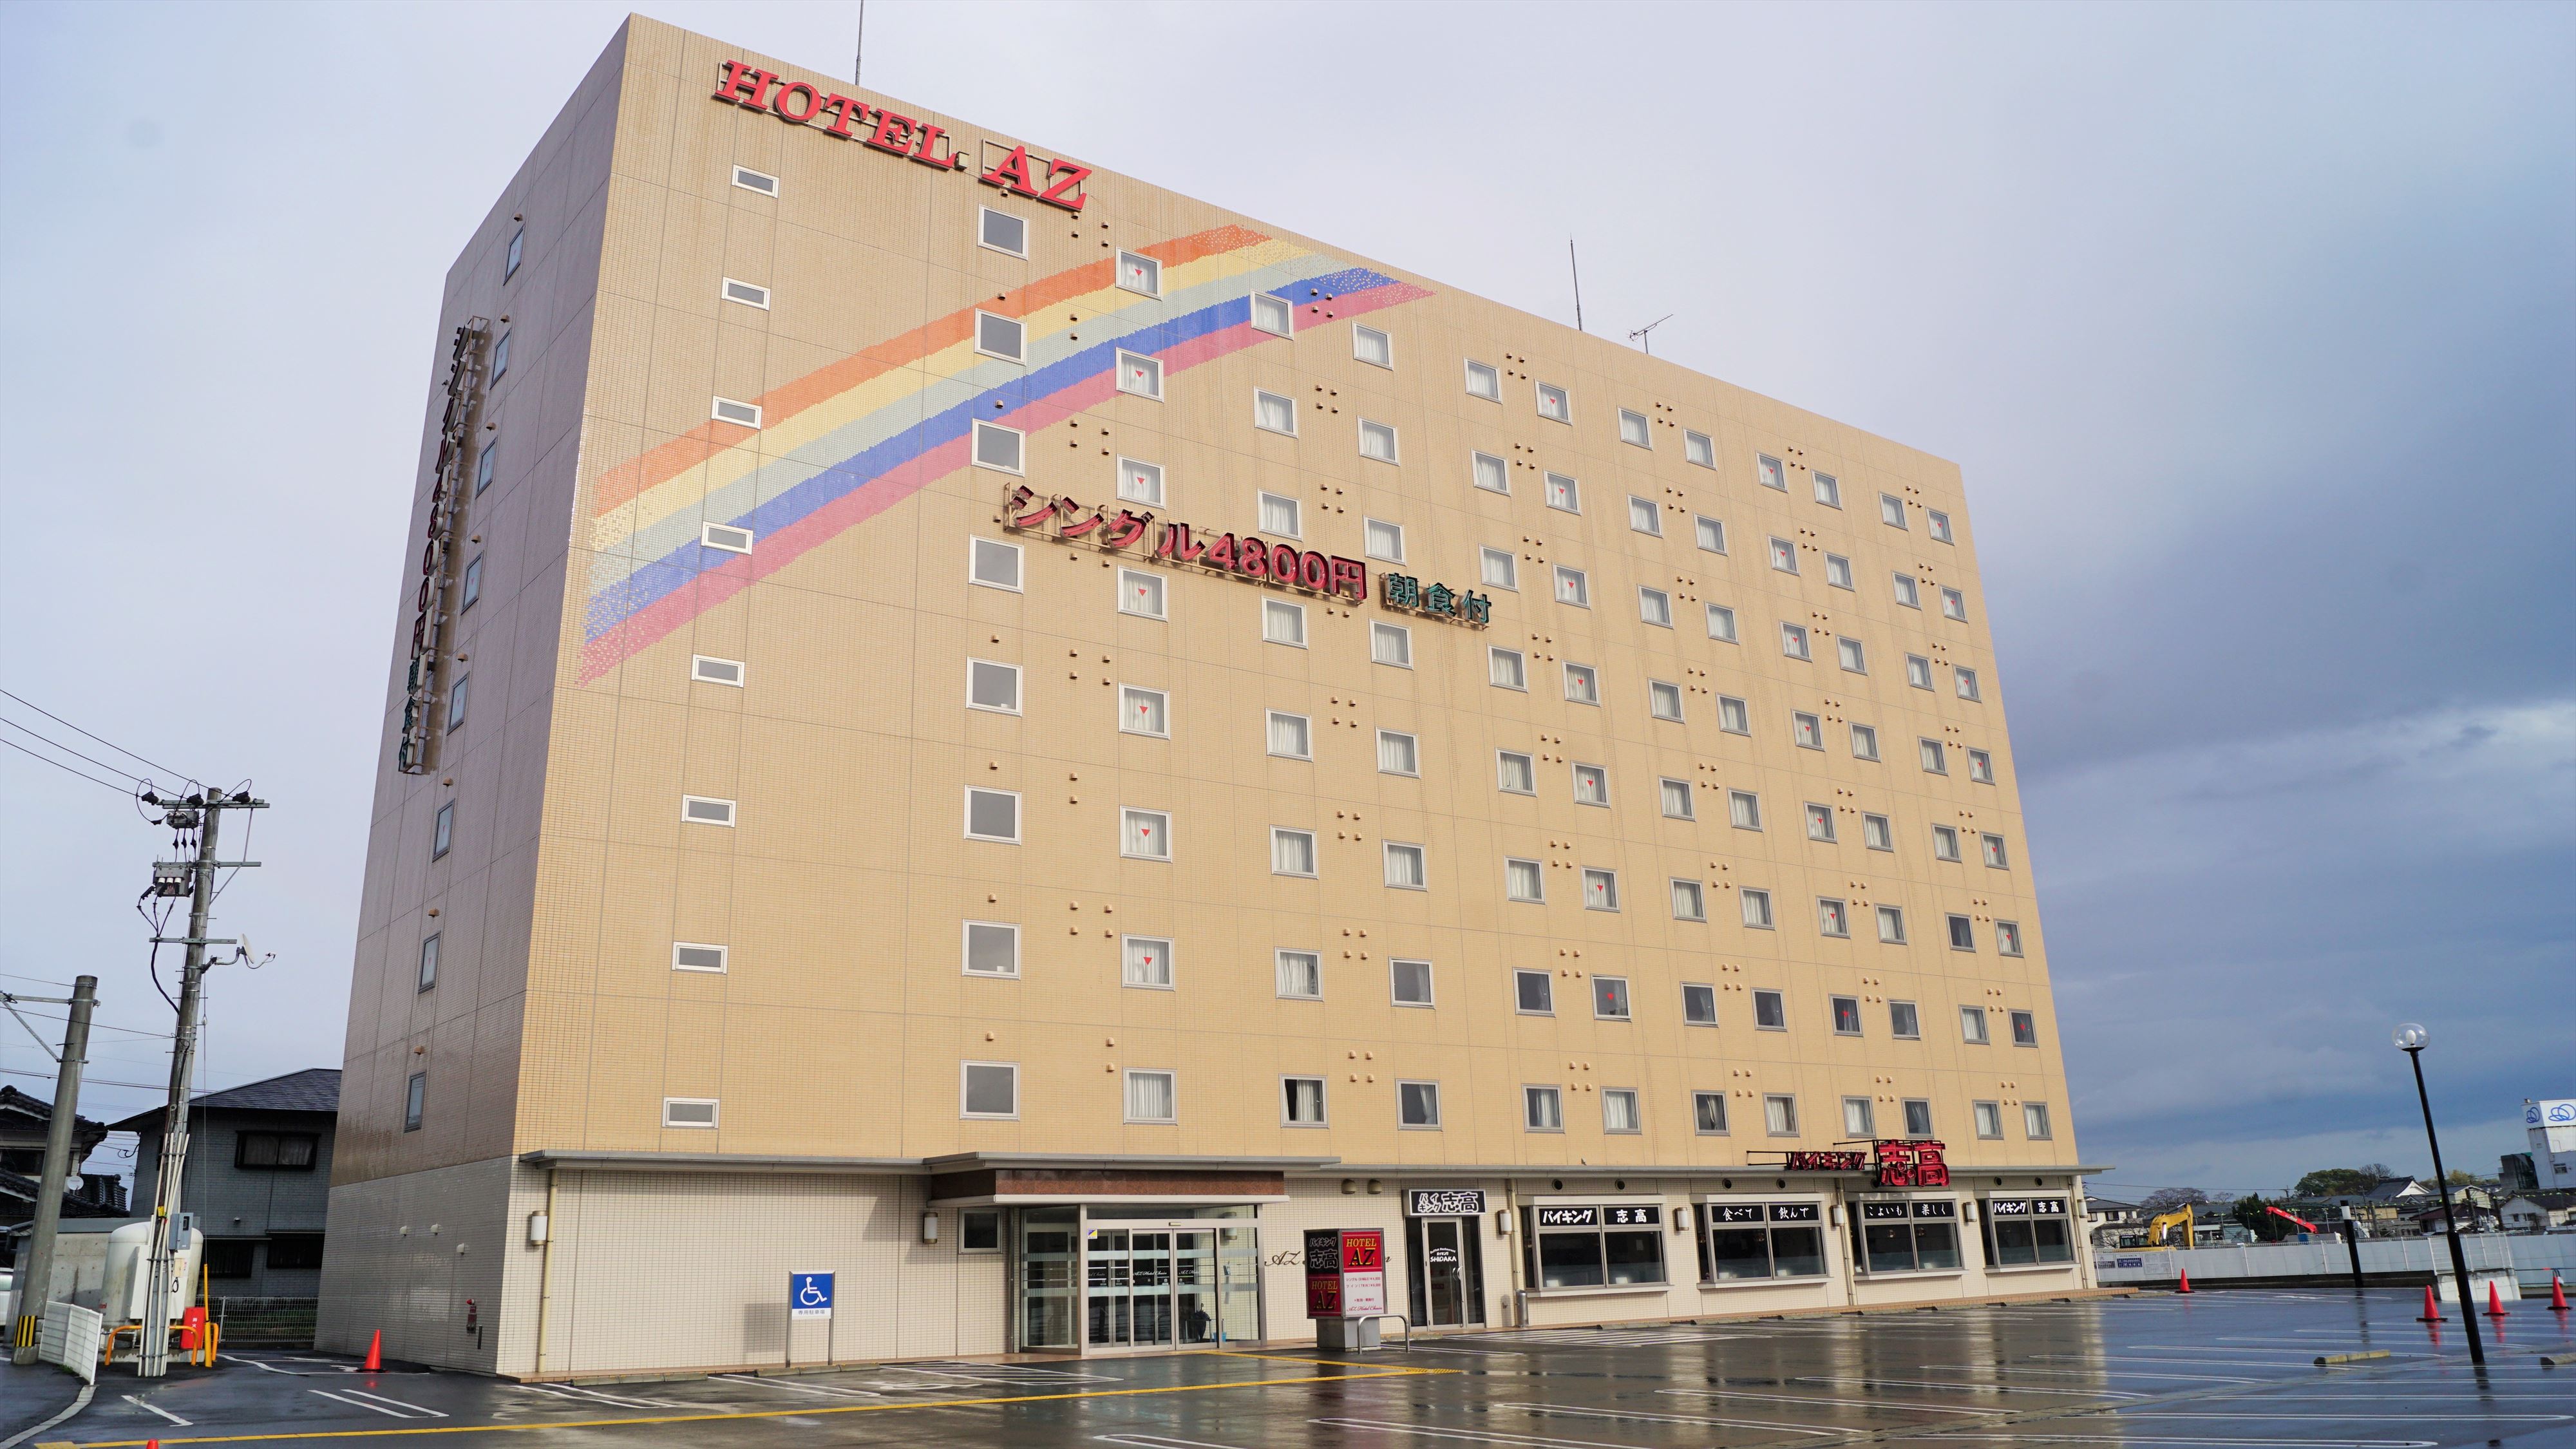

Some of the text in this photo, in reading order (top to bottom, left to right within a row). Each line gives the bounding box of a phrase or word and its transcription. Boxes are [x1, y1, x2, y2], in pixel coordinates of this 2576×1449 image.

[714, 59, 1092, 212] HOTEL AZ
[1009, 485, 1492, 624] シングル4800円 朝食付
[1792, 1139, 1949, 1187] バイキング 志高
[1441, 1191, 1479, 1212] 志高
[1994, 1201, 2059, 1213] バイキング 志高
[1543, 1209, 1647, 1224] バイキング 志高
[1723, 1207, 1809, 1221] 食べて 飲んで
[1869, 1204, 1945, 1216] こよいも 楽しく
[1309, 1237, 1336, 1247] バイキング
[1346, 1238, 1376, 1247] HOTEL
[1265, 1251, 1301, 1266] AZ
[1310, 1249, 1338, 1268] 志高
[1349, 1247, 1376, 1266] AZ
[1311, 1280, 1338, 1290] HOTEL
[1314, 1291, 1336, 1309] AZ
